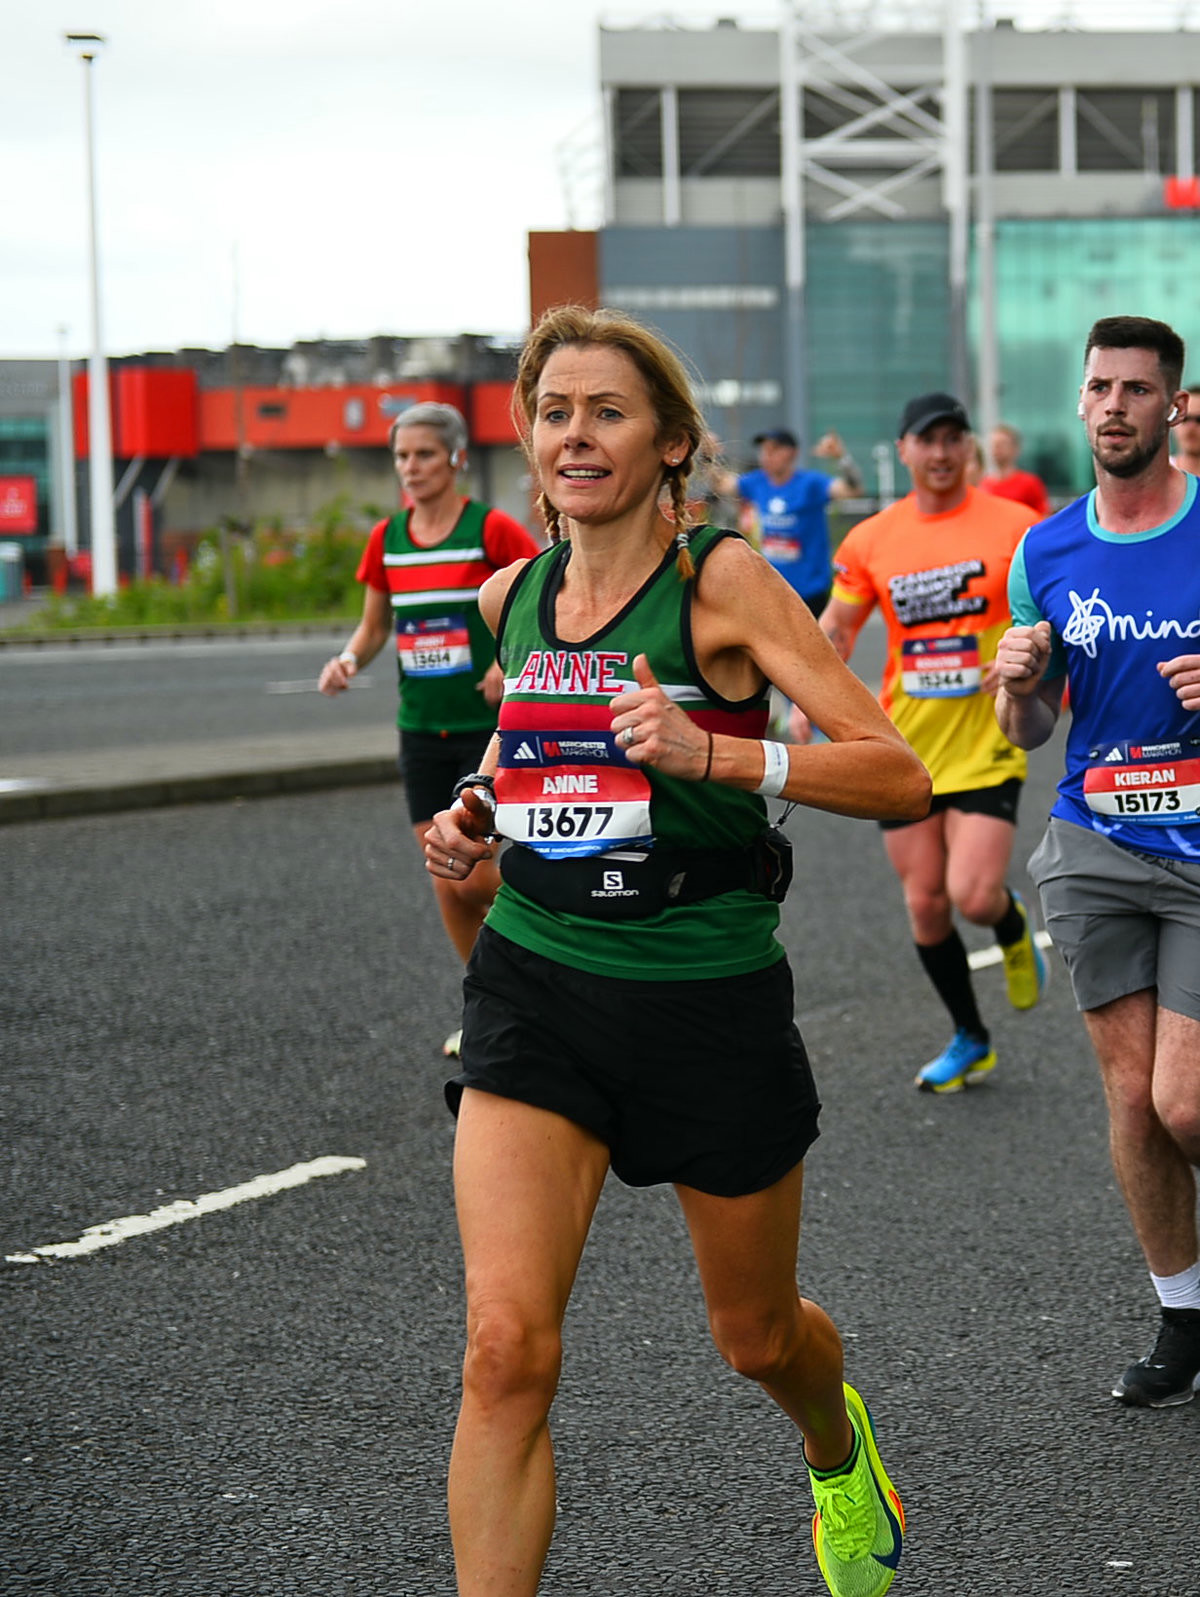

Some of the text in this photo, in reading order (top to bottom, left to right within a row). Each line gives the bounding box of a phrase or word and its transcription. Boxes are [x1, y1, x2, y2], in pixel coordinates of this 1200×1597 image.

[514, 651, 628, 694] ANNE
[542, 775, 599, 794] ANNE
[1114, 768, 1176, 787] KIERAN
[1114, 790, 1181, 813] 15173
[526, 807, 614, 838] 13677
